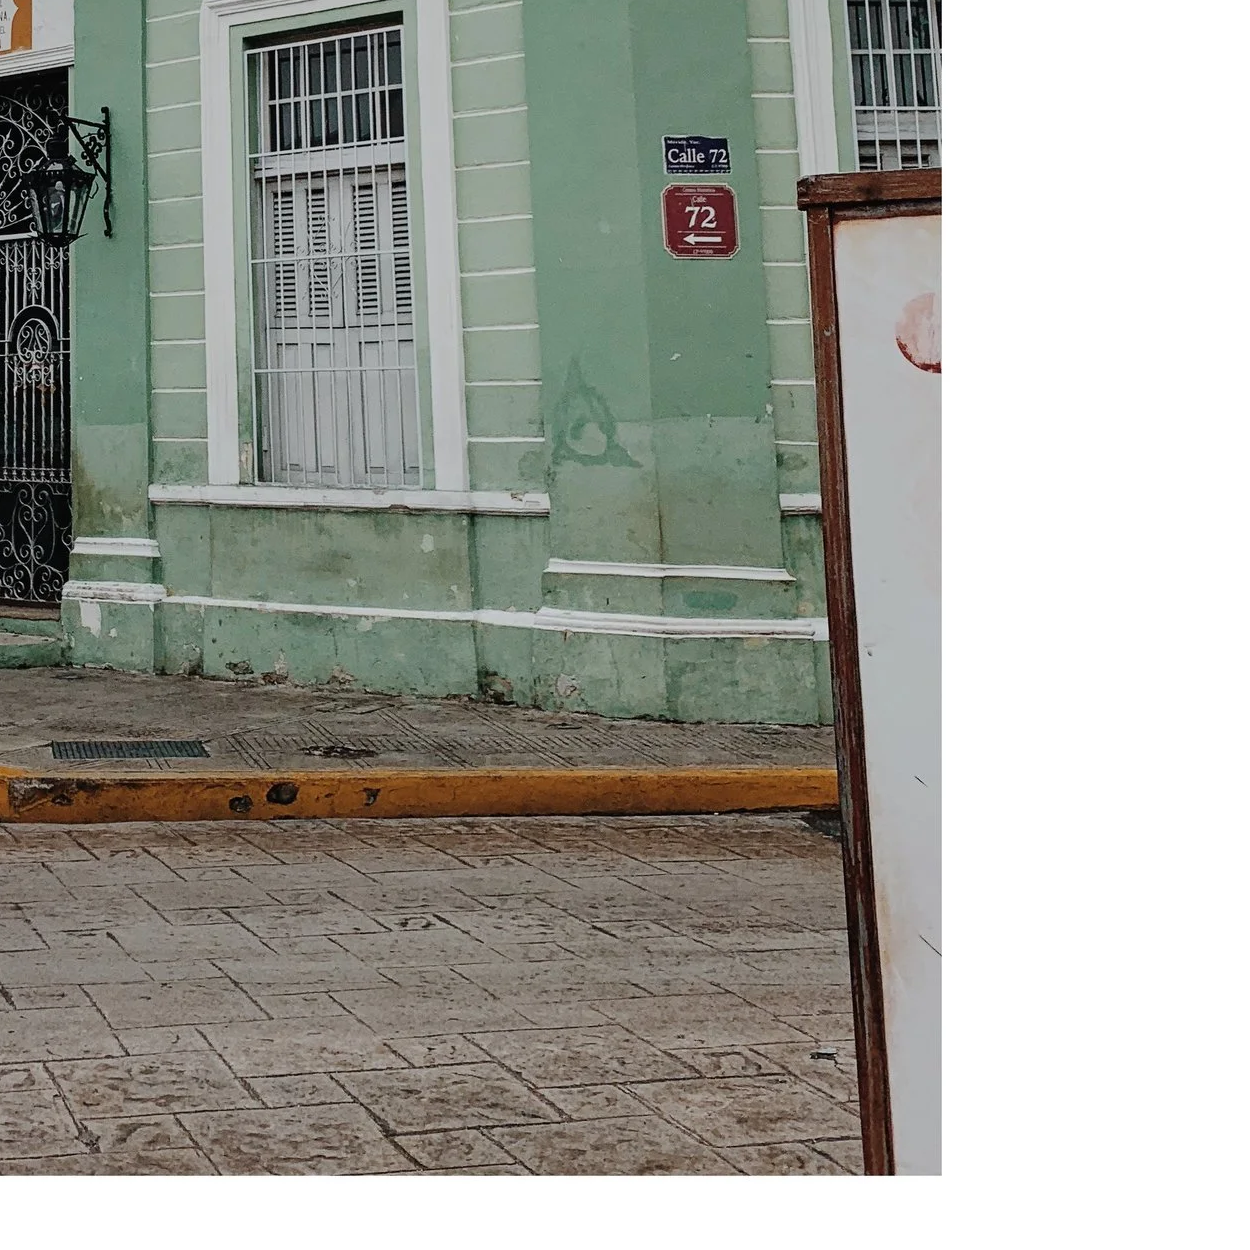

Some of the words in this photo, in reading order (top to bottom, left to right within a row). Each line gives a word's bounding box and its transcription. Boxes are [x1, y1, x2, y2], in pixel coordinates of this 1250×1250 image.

[667, 147, 706, 163] Calle
[709, 148, 728, 163] 72
[685, 206, 717, 228] 72
